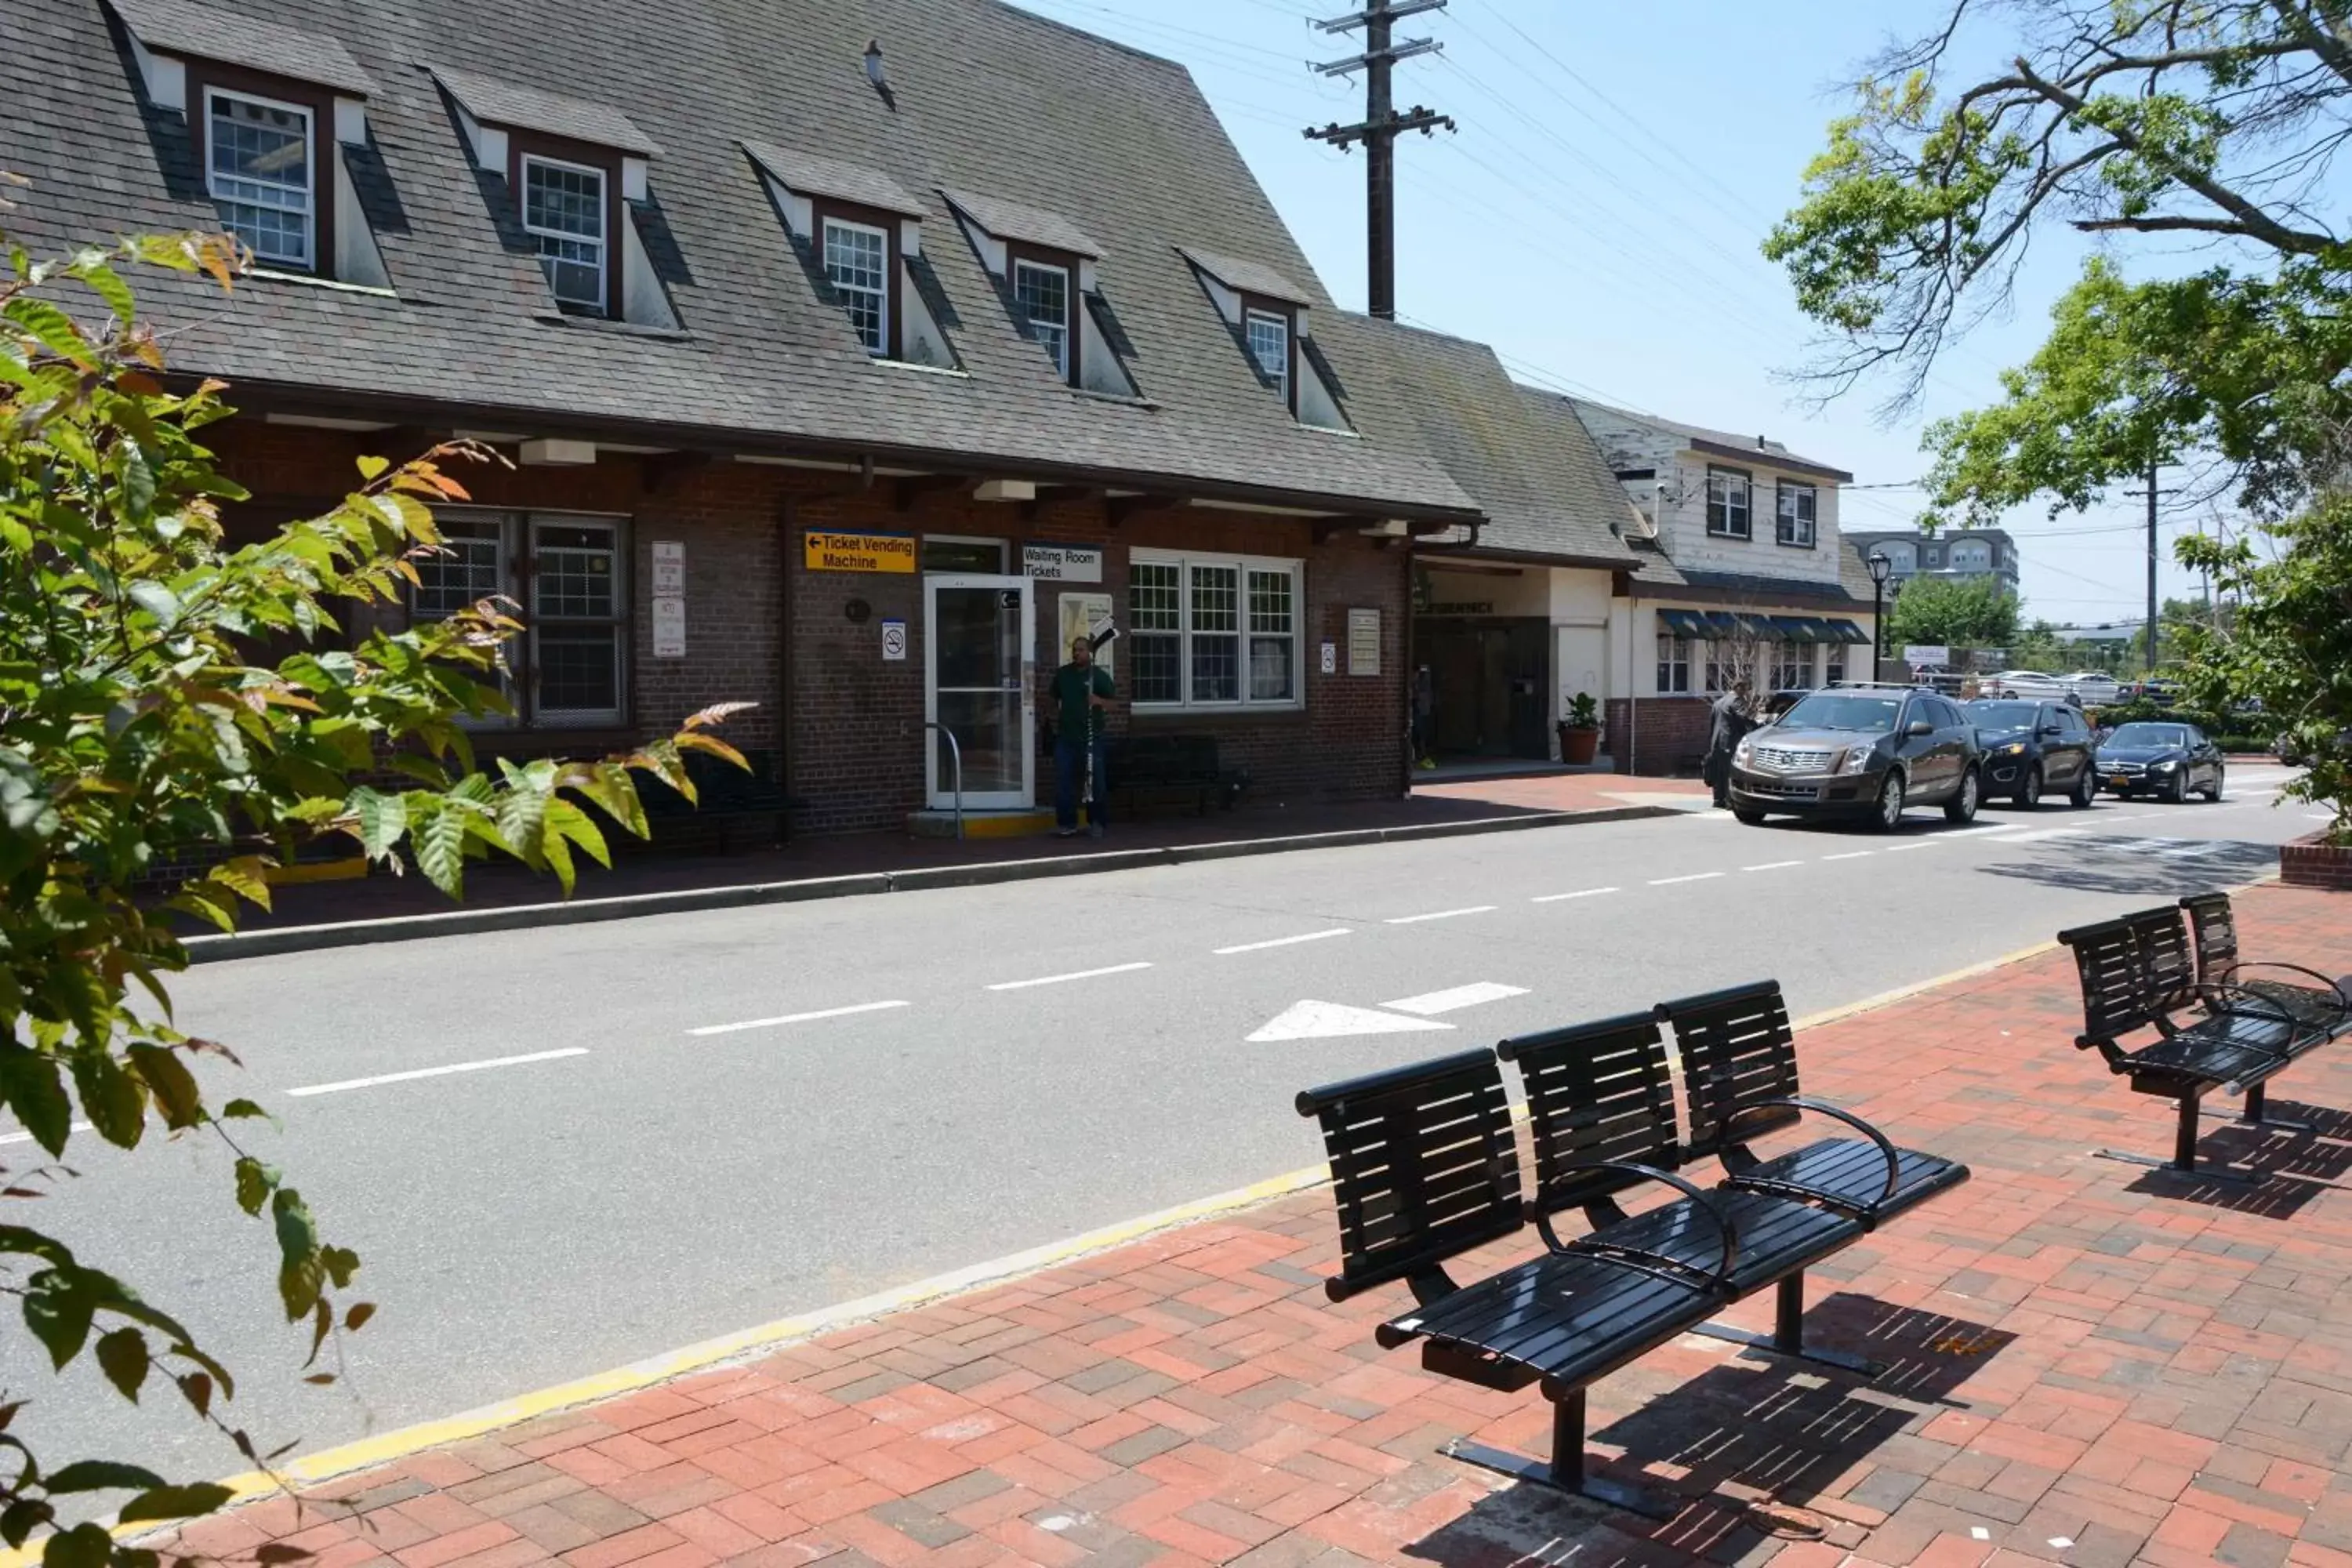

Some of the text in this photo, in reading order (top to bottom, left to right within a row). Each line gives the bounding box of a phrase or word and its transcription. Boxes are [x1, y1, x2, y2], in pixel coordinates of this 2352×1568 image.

[822, 536, 913, 557] Ticket Vending
[823, 553, 878, 569] Machine
[1025, 549, 1094, 564] Waiting Room
[1025, 564, 1062, 578] Tickets
